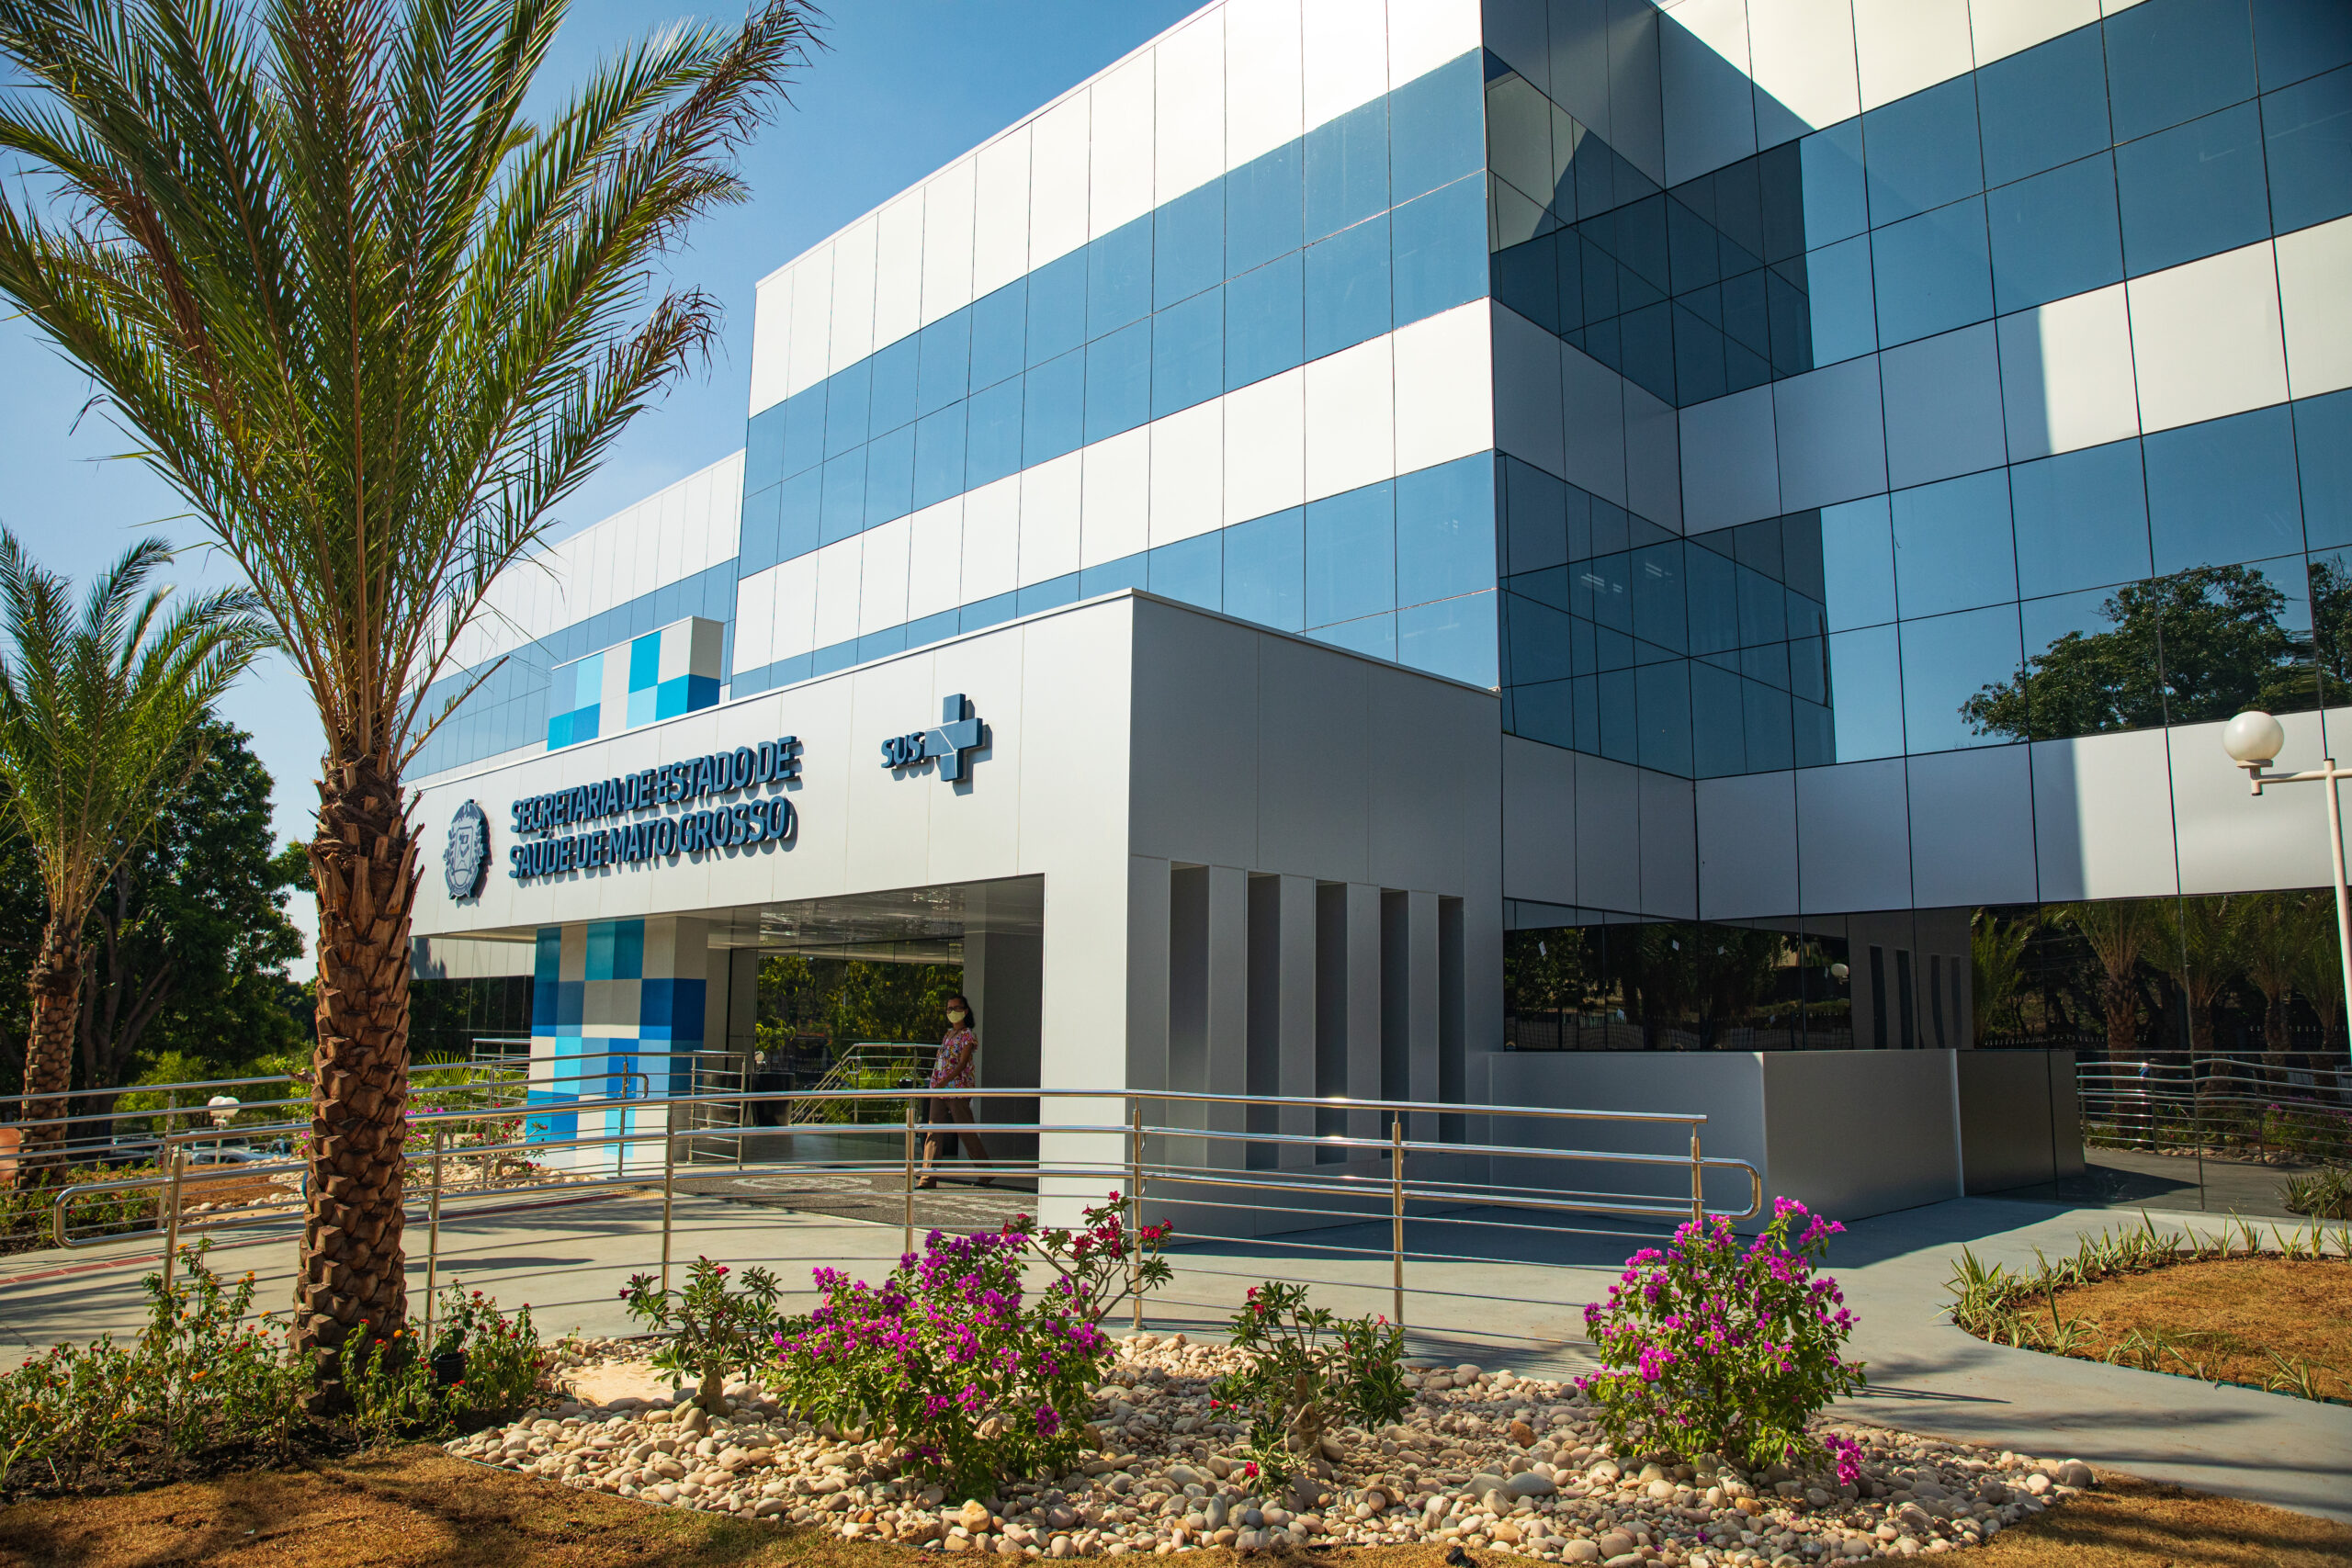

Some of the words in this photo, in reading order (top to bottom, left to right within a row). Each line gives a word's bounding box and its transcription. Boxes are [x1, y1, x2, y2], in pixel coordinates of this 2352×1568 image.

[510, 777, 624, 833] SECRETARIA
[624, 768, 656, 810] DE
[656, 746, 754, 804] ESTADO
[757, 736, 797, 784] DE
[880, 731, 925, 768] SUS
[509, 830, 575, 879] SAÚDE
[575, 829, 606, 869] DE
[608, 817, 675, 864] MATO
[677, 795, 791, 852] GROSSO
